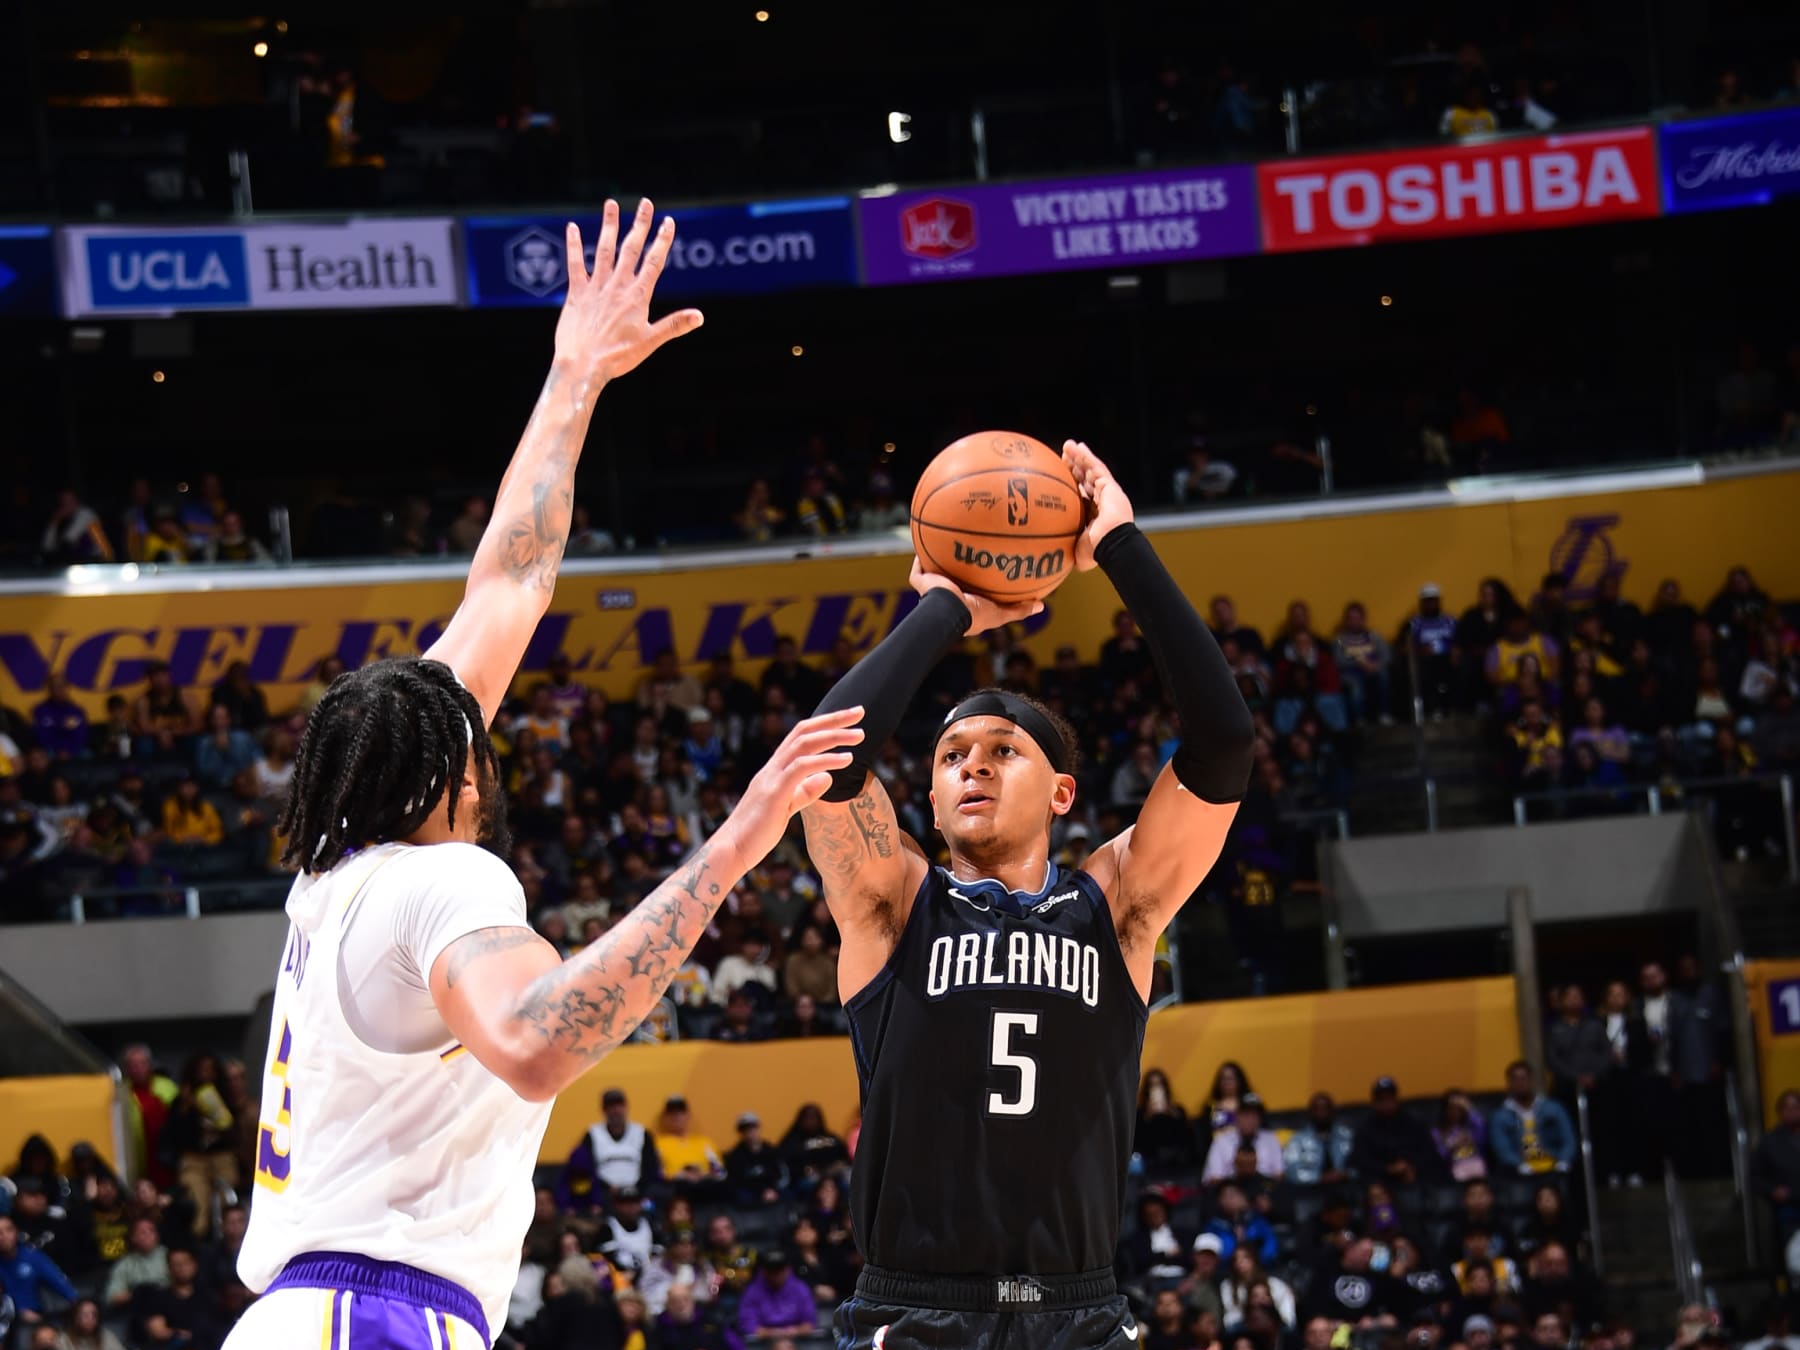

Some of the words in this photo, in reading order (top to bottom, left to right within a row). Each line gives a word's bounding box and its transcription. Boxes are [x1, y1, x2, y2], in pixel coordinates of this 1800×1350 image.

[1013, 189, 1127, 227] VICTORY
[1131, 179, 1228, 217] TASTES
[1276, 146, 1639, 234] TOSHIBA
[1053, 227, 1114, 260] LIKE
[1119, 219, 1200, 254] TACOS
[108, 250, 231, 292] UCLA
[263, 243, 437, 293] Health
[953, 541, 1065, 581] Wilson
[1031, 890, 1080, 914] Disney
[927, 931, 1100, 1007] ORLANDO
[988, 1012, 1038, 1115] 5
[997, 1281, 1042, 1303] MAGIC
